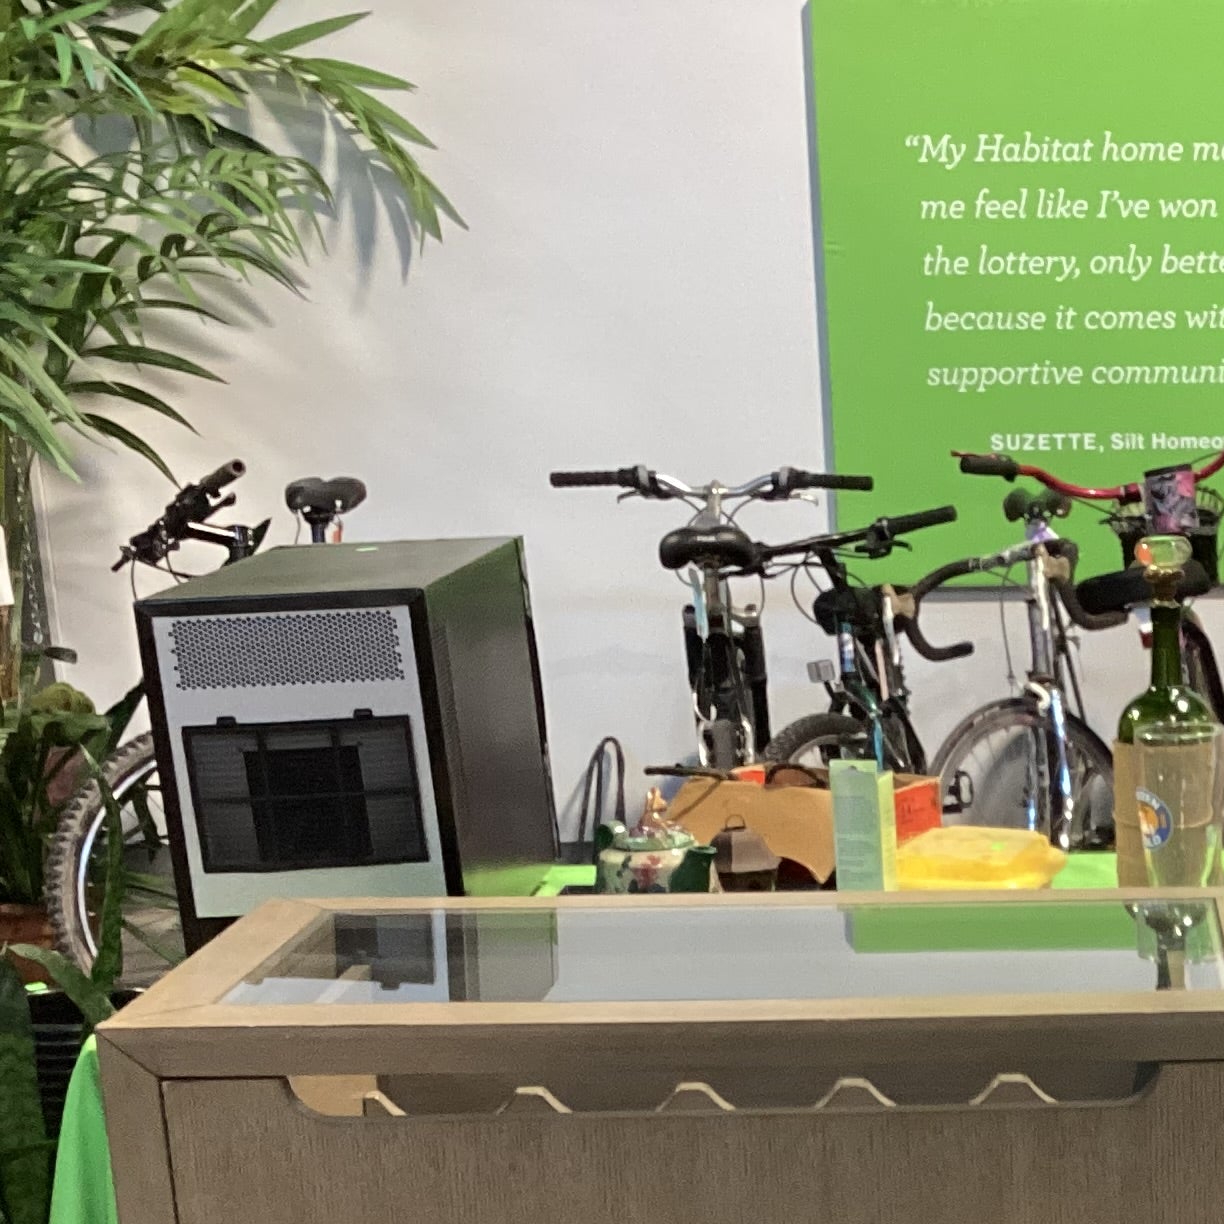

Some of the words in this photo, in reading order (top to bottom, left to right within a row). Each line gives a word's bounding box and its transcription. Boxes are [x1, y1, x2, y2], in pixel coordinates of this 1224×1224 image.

[974, 131, 1094, 163] Habitat
[1102, 131, 1184, 162] home
[920, 198, 965, 219] me
[974, 188, 1028, 220] feel
[1037, 188, 1089, 219] like
[1159, 199, 1218, 219] won
[924, 244, 970, 276] the
[979, 244, 1081, 281] lottery,
[1090, 244, 1152, 281] only
[925, 301, 1047, 331] because
[1056, 304, 1077, 330] it
[1084, 311, 1177, 330] comes
[927, 357, 1084, 393] supportive
[990, 433, 1105, 453] SUZETTE,
[1110, 432, 1145, 450] Silt
